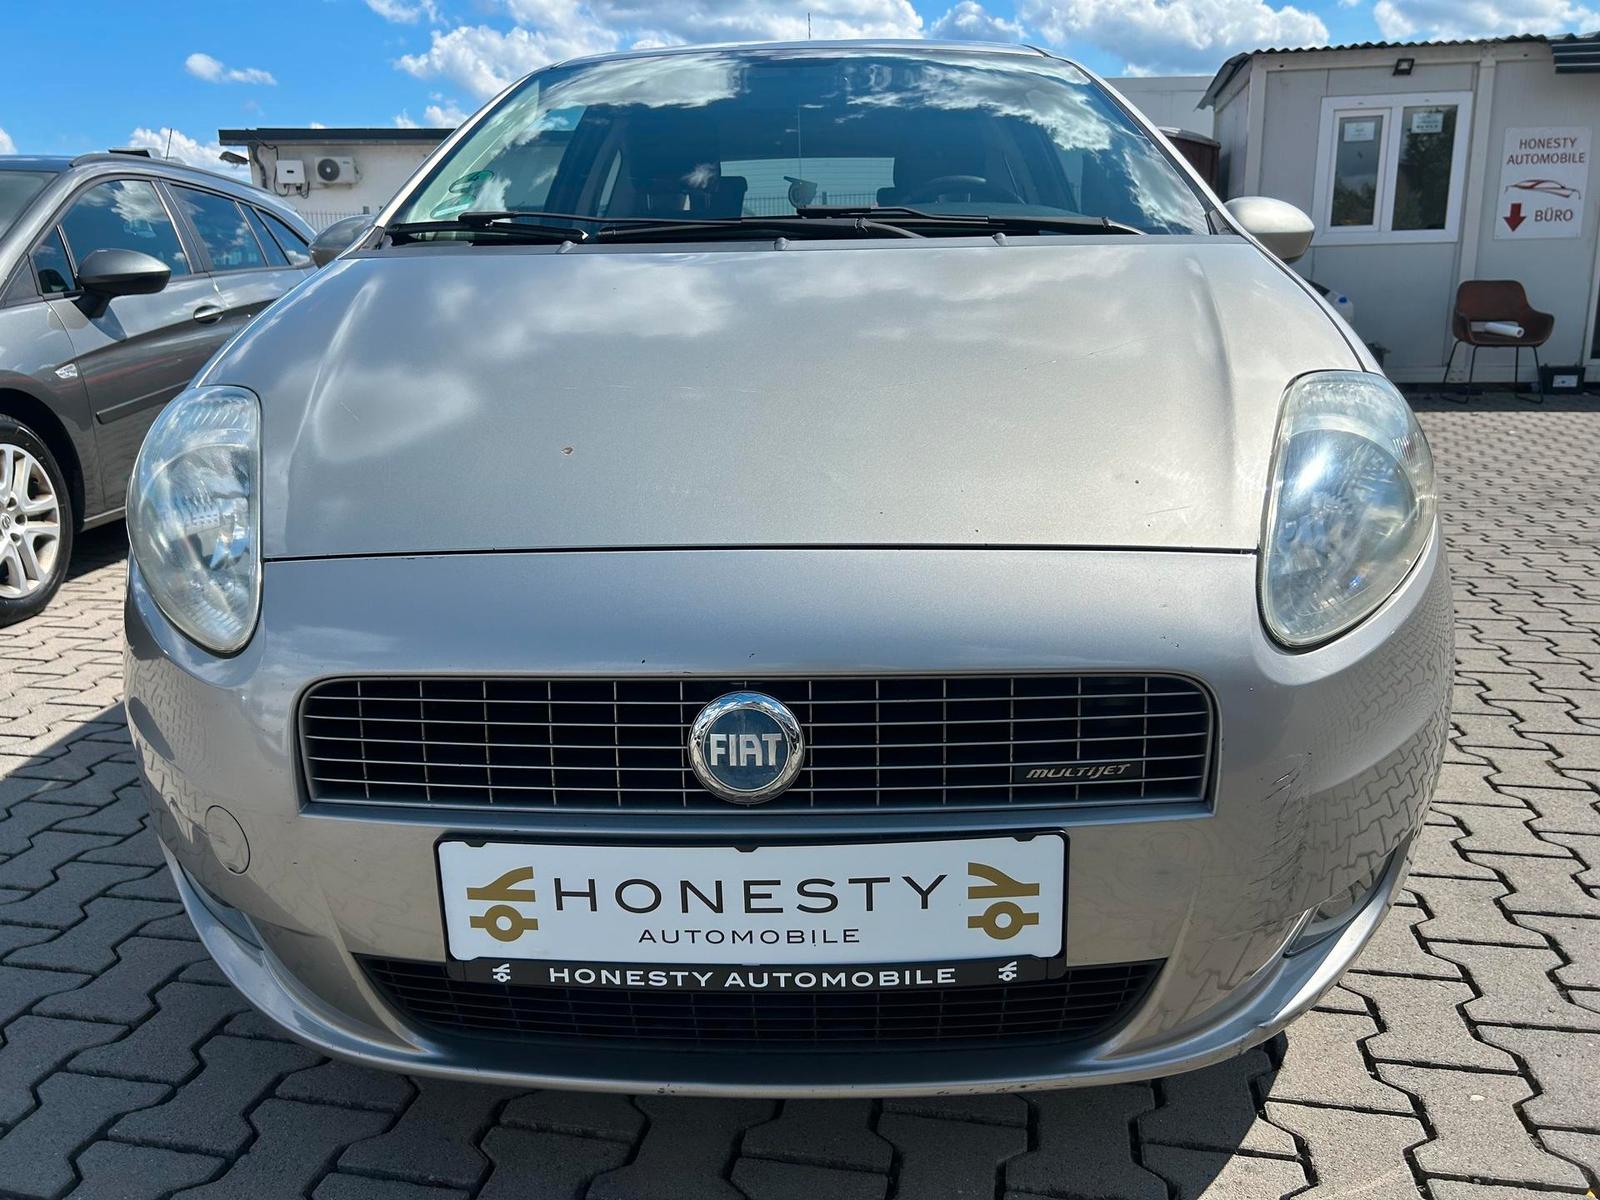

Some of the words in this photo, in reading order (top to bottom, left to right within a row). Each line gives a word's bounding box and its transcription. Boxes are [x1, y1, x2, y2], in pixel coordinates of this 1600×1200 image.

[1519, 137, 1578, 150] HONESTY
[1506, 152, 1585, 165] AUTOMOBILE
[1534, 207, 1574, 222] BÜRO
[709, 733, 782, 767] FIAT
[1026, 763, 1131, 779] MULTIJET
[554, 874, 948, 914] HONESTY
[638, 928, 861, 946] AUTOMOBILE
[549, 967, 713, 987] HONESTY
[724, 967, 956, 989] AUTOMOBILE
